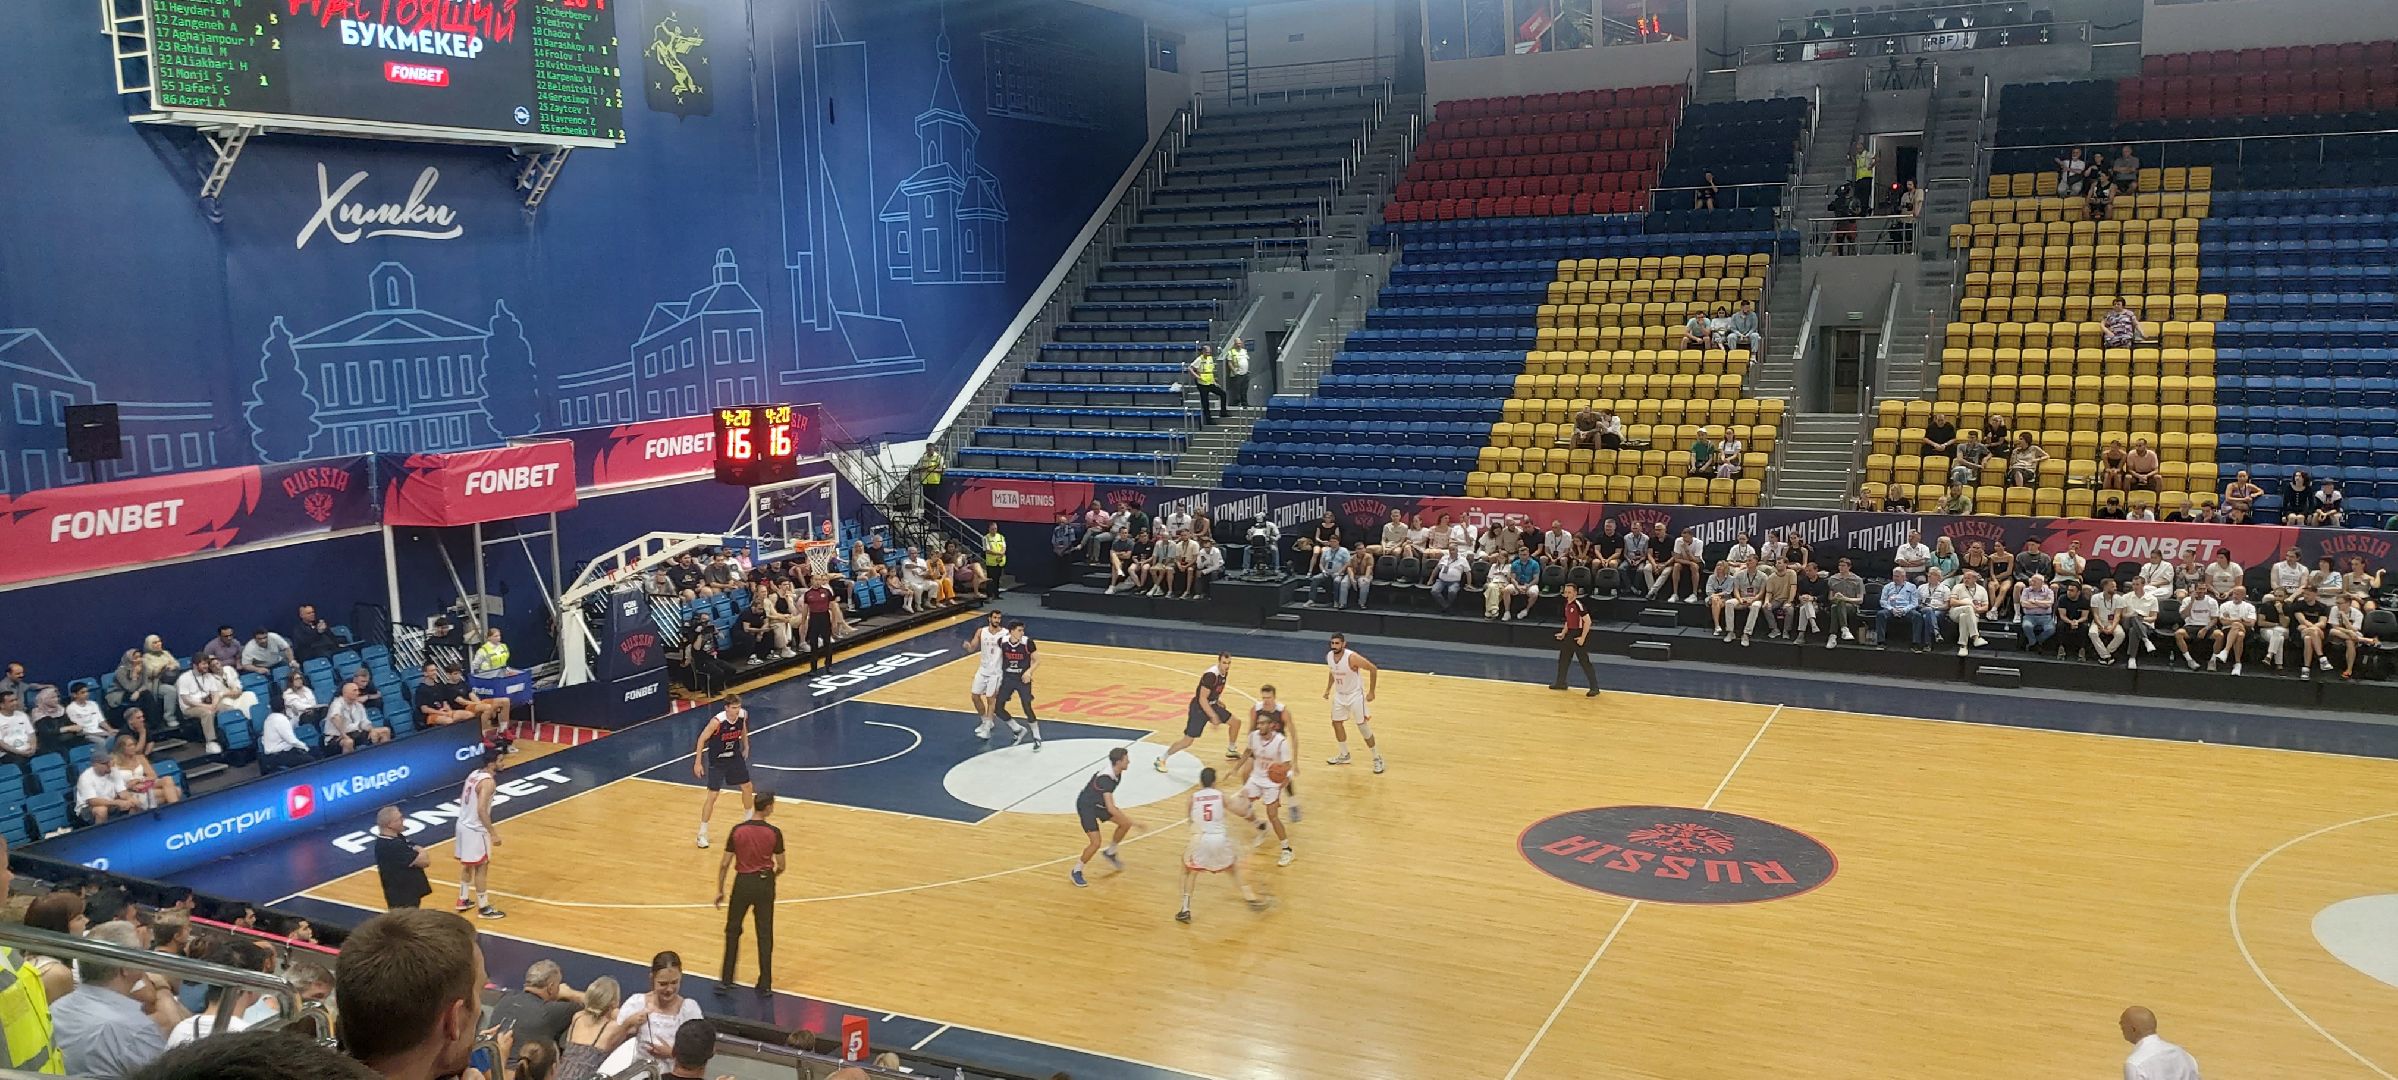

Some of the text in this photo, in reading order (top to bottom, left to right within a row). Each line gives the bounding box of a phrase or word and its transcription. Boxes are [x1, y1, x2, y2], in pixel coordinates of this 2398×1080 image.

[153, 1, 166, 11] 11
[169, 2, 216, 17] Heydari
[270, 13, 278, 25] 5
[155, 14, 264, 36] 12 Zangeneh A 2
[156, 27, 170, 38] 17
[172, 29, 245, 45] Aghajanpour
[271, 38, 280, 50] 2
[157, 41, 171, 51] 23
[173, 42, 214, 55] Rahimi
[340, 19, 483, 59] БУКМЕКЕР
[534, 38, 543, 46] 11
[601, 46, 608, 55] 1
[611, 37, 618, 46] 2
[159, 54, 173, 65] 32
[175, 56, 235, 70] Aliakbari
[603, 67, 609, 76] 1
[161, 67, 268, 86] 51 Monji S 1
[391, 65, 444, 82] FONBET
[161, 80, 231, 95] 55 Jafari S
[616, 88, 622, 98] 2
[162, 94, 227, 107] 86 Azari A
[605, 98, 612, 107] 2
[616, 99, 623, 108] 2
[608, 129, 614, 138] 1
[618, 129, 625, 139] 2
[297, 162, 457, 249] Химки
[722, 410, 752, 427] 4:20
[765, 406, 791, 425] 4:20
[644, 432, 716, 460] FONBET
[727, 428, 752, 459] 16
[769, 425, 792, 456] 16
[282, 467, 350, 499] RUSSIA
[464, 463, 560, 496] FONBET
[1020, 494, 1055, 507] RATINGS
[1106, 489, 1146, 505] RUSSIA
[1274, 497, 1327, 529] СТРАНЫ
[1341, 498, 1388, 517] RUSSIA
[50, 499, 184, 543] FONBET
[1943, 520, 2005, 541] RUSSIA
[2092, 535, 2221, 561] FONBET
[2320, 534, 2392, 559] RUSSIA
[623, 600, 637, 609] FON
[625, 607, 639, 617] BET
[620, 634, 655, 654] RUSSIA
[808, 649, 949, 697] JÖGEL
[625, 683, 659, 702] FONBET
[321, 765, 411, 801] VK Видео
[1203, 804, 1213, 821] 5
[166, 807, 271, 850] смотри
[1541, 835, 1797, 884] RUSSIA
